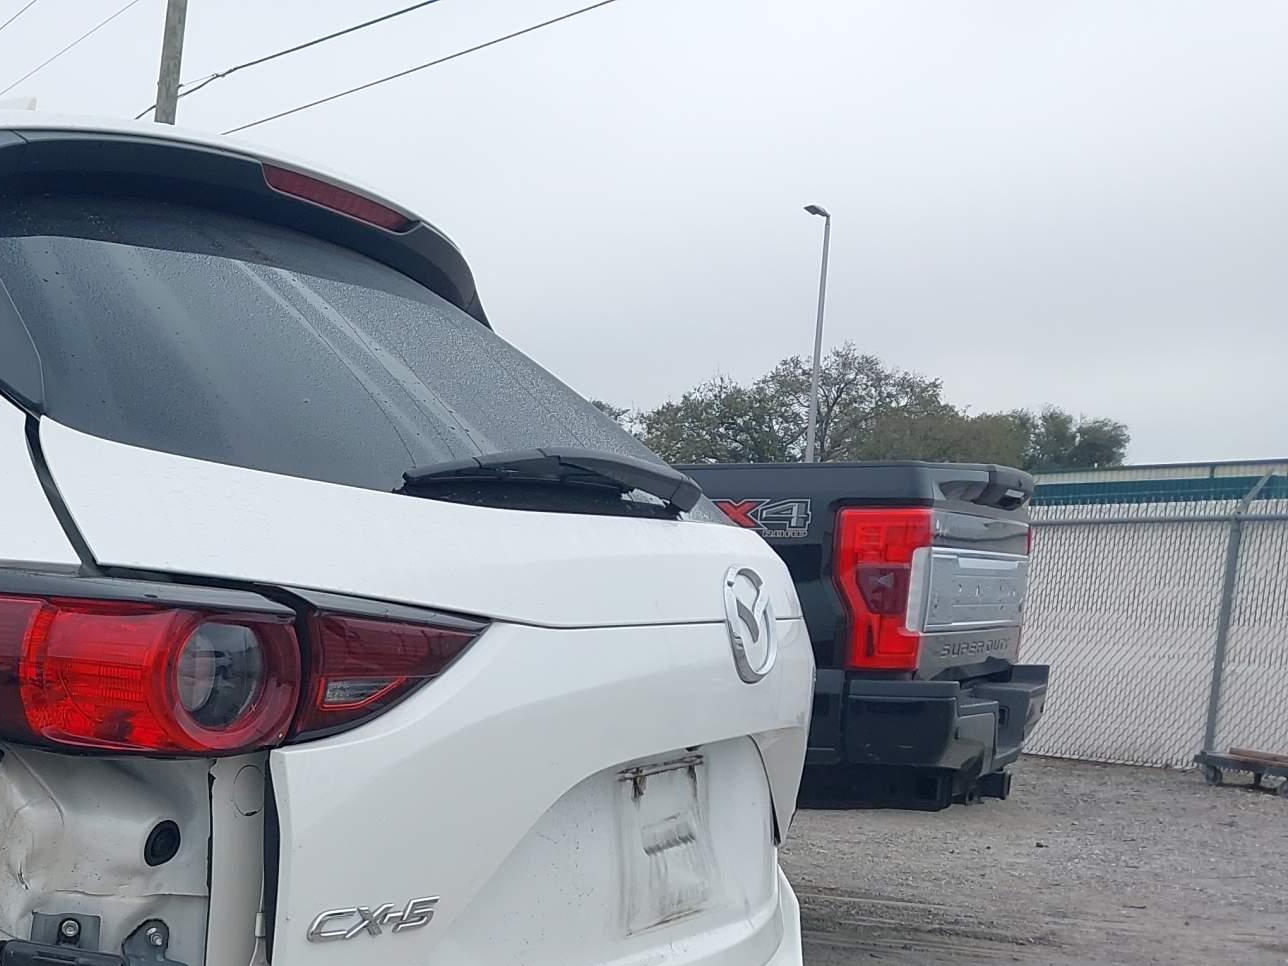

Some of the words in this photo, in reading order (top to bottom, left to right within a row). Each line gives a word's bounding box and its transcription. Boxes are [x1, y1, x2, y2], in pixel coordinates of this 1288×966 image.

[709, 498, 811, 530] X4
[939, 639, 986, 659] SUPER
[306, 895, 441, 943] CX-5
